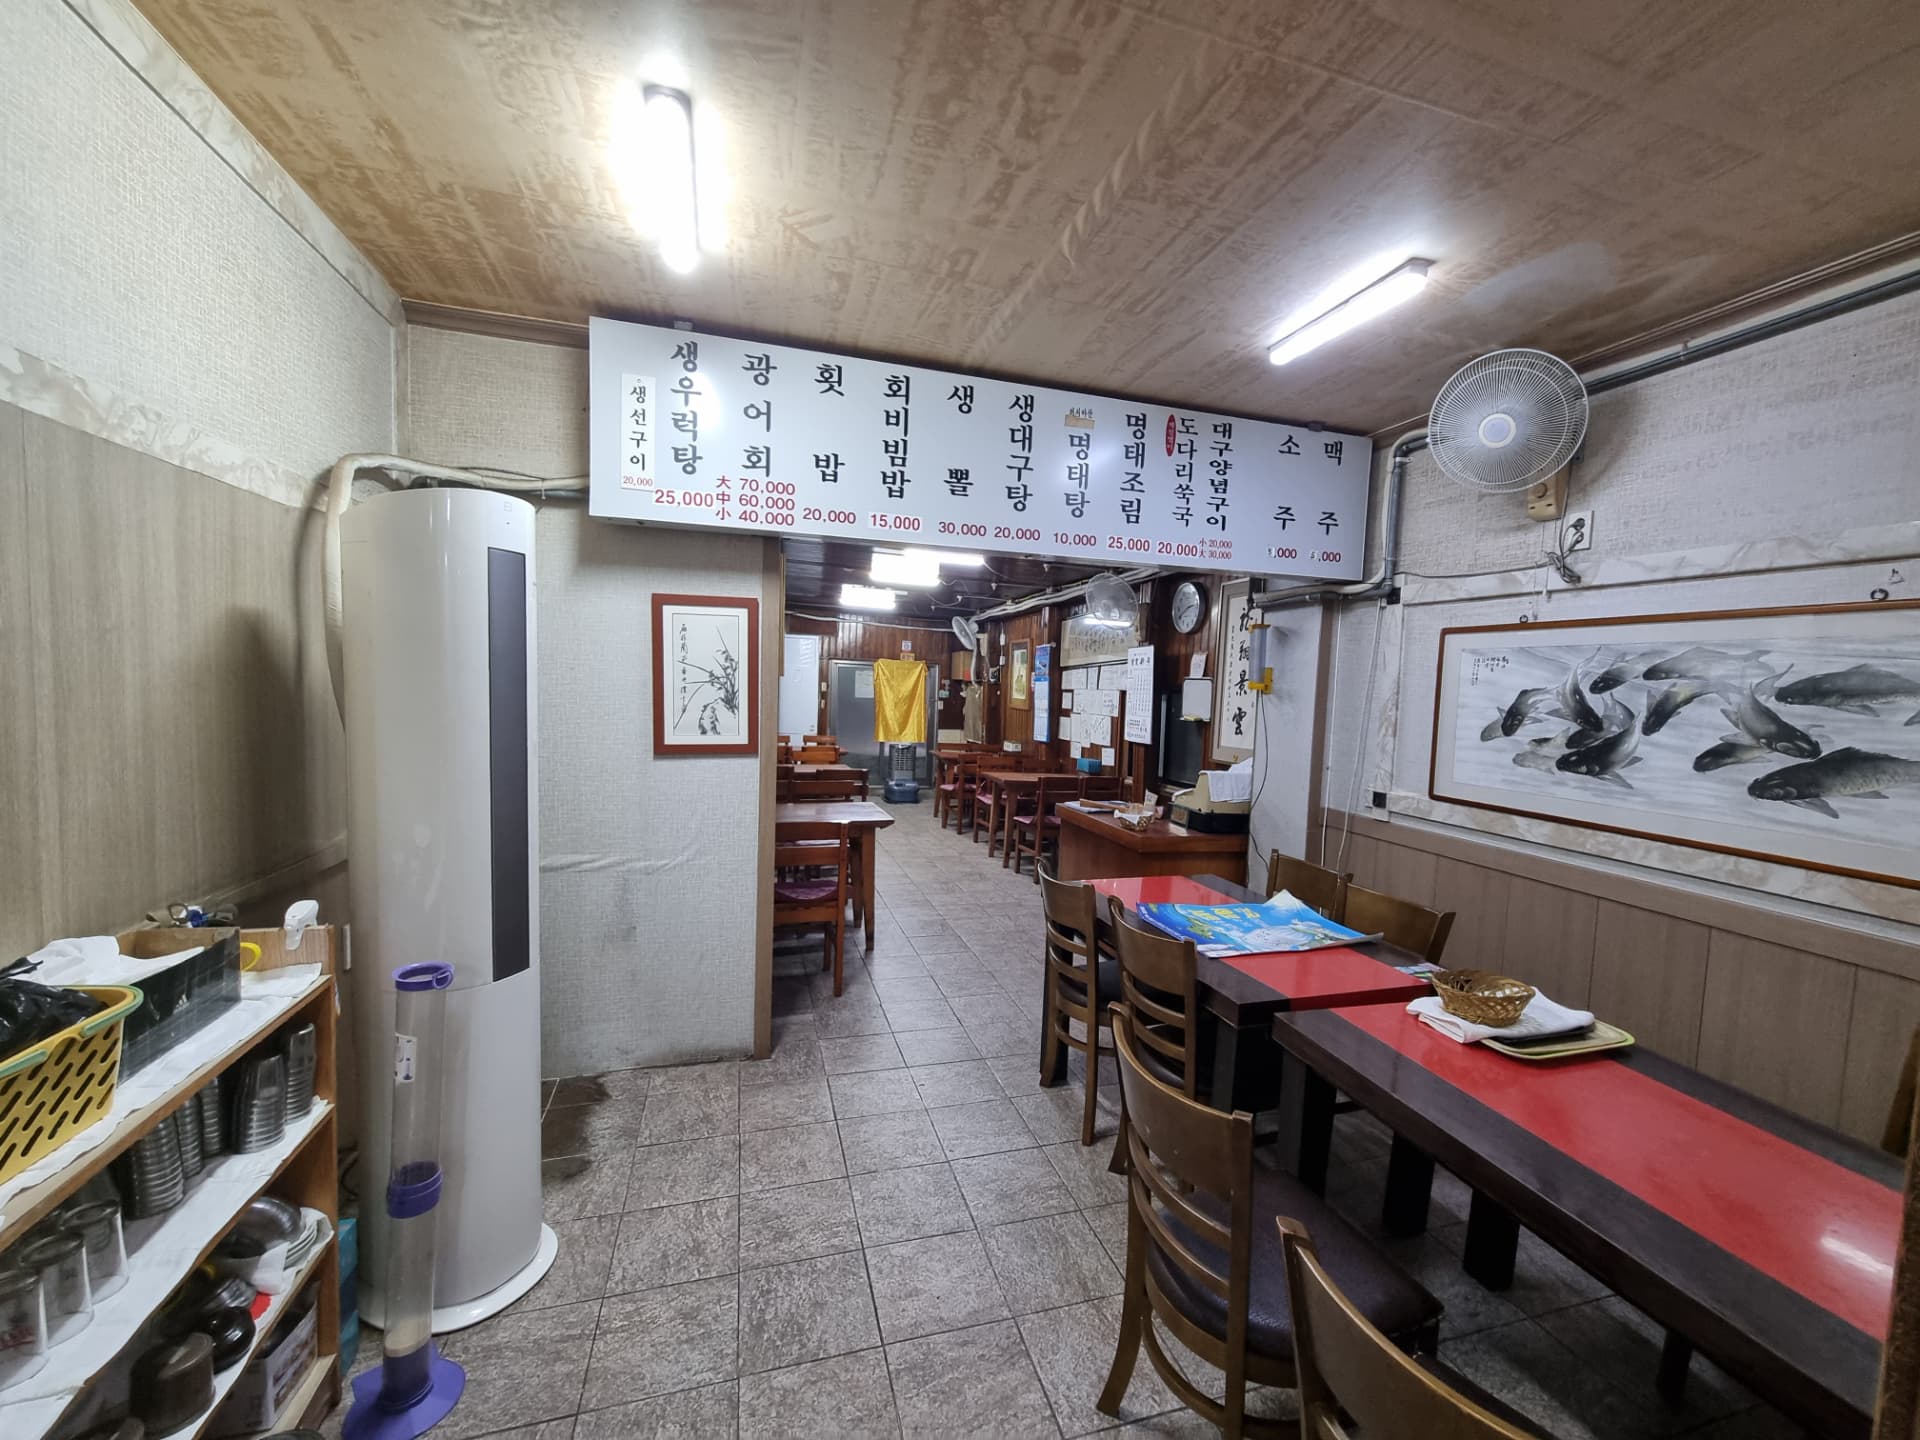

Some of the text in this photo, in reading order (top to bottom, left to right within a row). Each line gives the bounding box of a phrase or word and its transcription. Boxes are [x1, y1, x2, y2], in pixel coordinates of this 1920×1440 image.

[629, 386, 648, 471] 생선구이
[670, 341, 703, 475] 생우럭탕
[741, 353, 778, 477] 광어회
[813, 363, 845, 483] 횟밥
[881, 375, 912, 499] 회비빔밥
[1006, 394, 1035, 512] 생대구탕
[623, 475, 653, 487] 20,000
[716, 475, 796, 496] 大 70,000
[1064, 433, 1091, 518] 명태탕
[1120, 413, 1147, 525] 명태조림
[1172, 417, 1199, 527] 도다리쑥국
[1206, 422, 1233, 531] 대구양념구이
[1273, 434, 1301, 531] 소주
[1317, 440, 1344, 535] 맥주
[655, 489, 714, 508] 25,000
[715, 506, 795, 526] 小 40,000
[716, 492, 796, 511] 中 60,000
[802, 508, 857, 524] 20,000
[870, 513, 921, 531] 15,000
[938, 521, 987, 537] 30,000
[994, 526, 1041, 541] 20,000
[1053, 532, 1097, 546] 10,000
[1108, 536, 1151, 552] 25,000
[1158, 541, 1198, 557] 20,000
